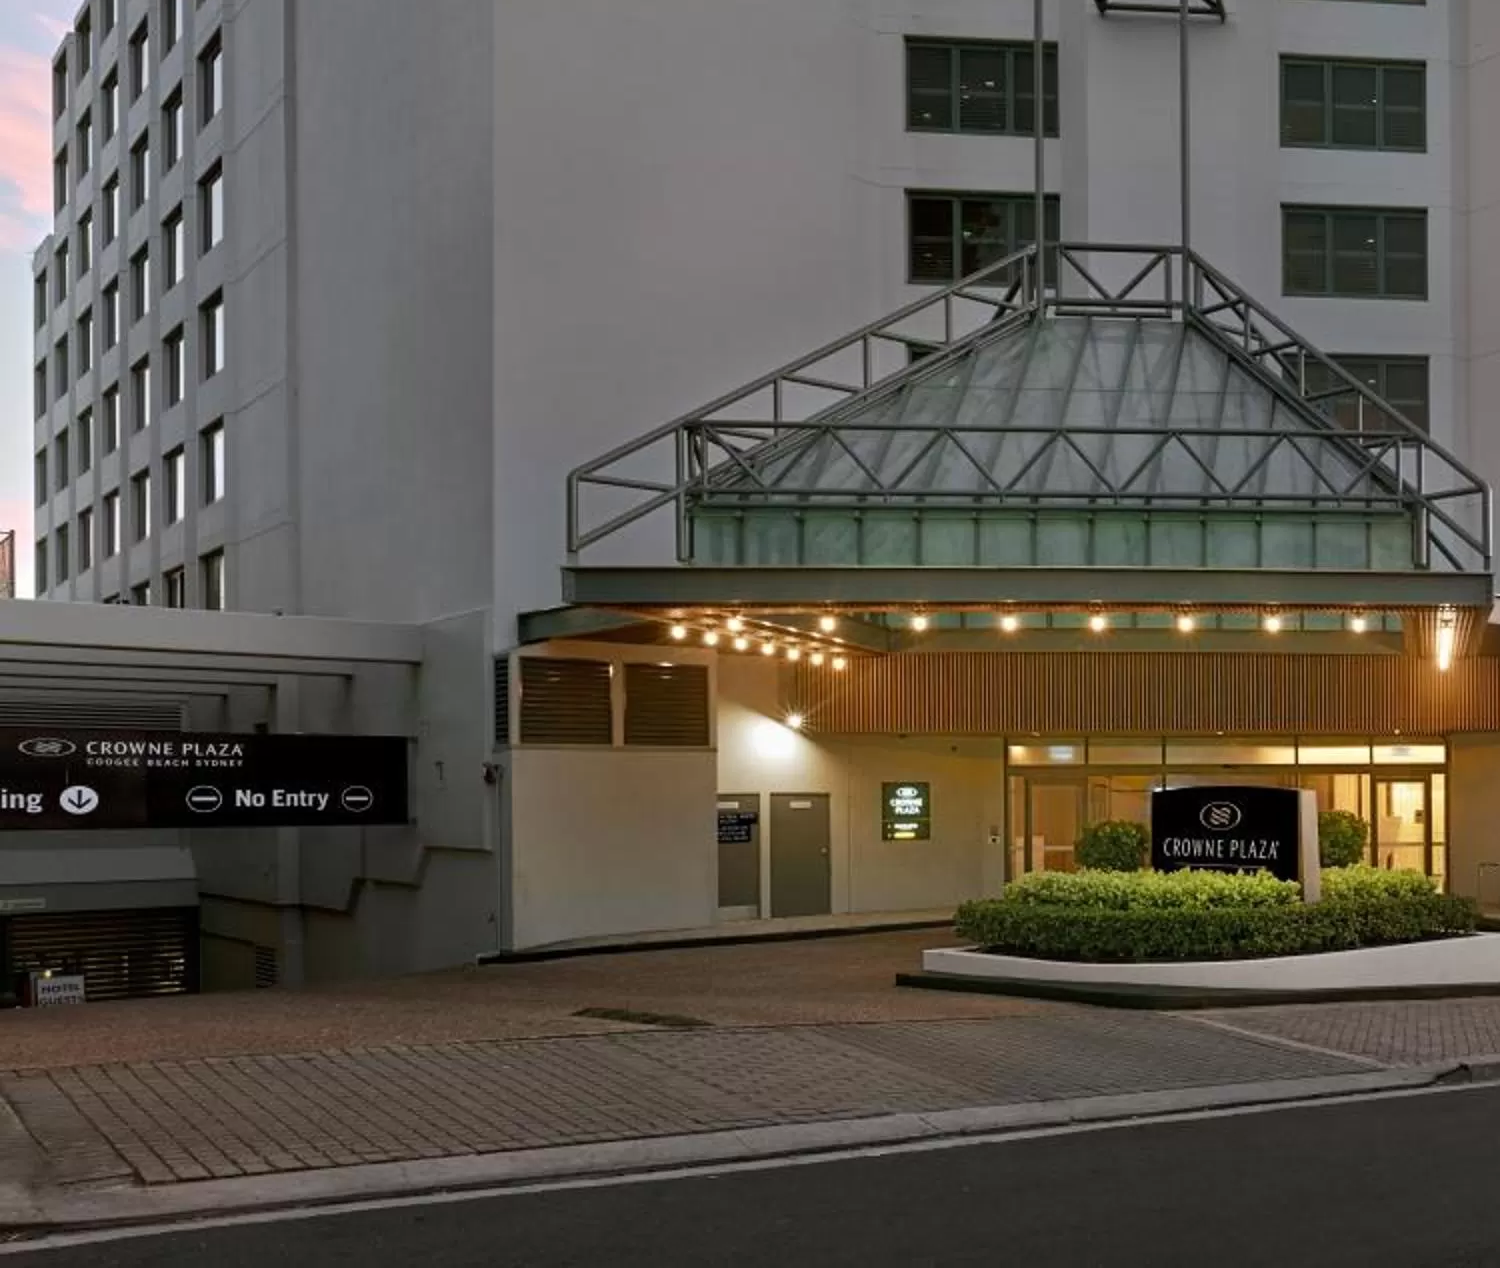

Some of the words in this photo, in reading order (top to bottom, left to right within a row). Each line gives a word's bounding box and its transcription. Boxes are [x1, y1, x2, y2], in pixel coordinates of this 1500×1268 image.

[86, 740, 174, 756] CROWNE
[182, 742, 244, 757] PLAZA
[147, 758, 189, 767] BEACH
[235, 788, 265, 807] No
[272, 788, 329, 811] Entry
[1163, 837, 1224, 858] CROWNE
[1229, 839, 1277, 860] PLAZA
